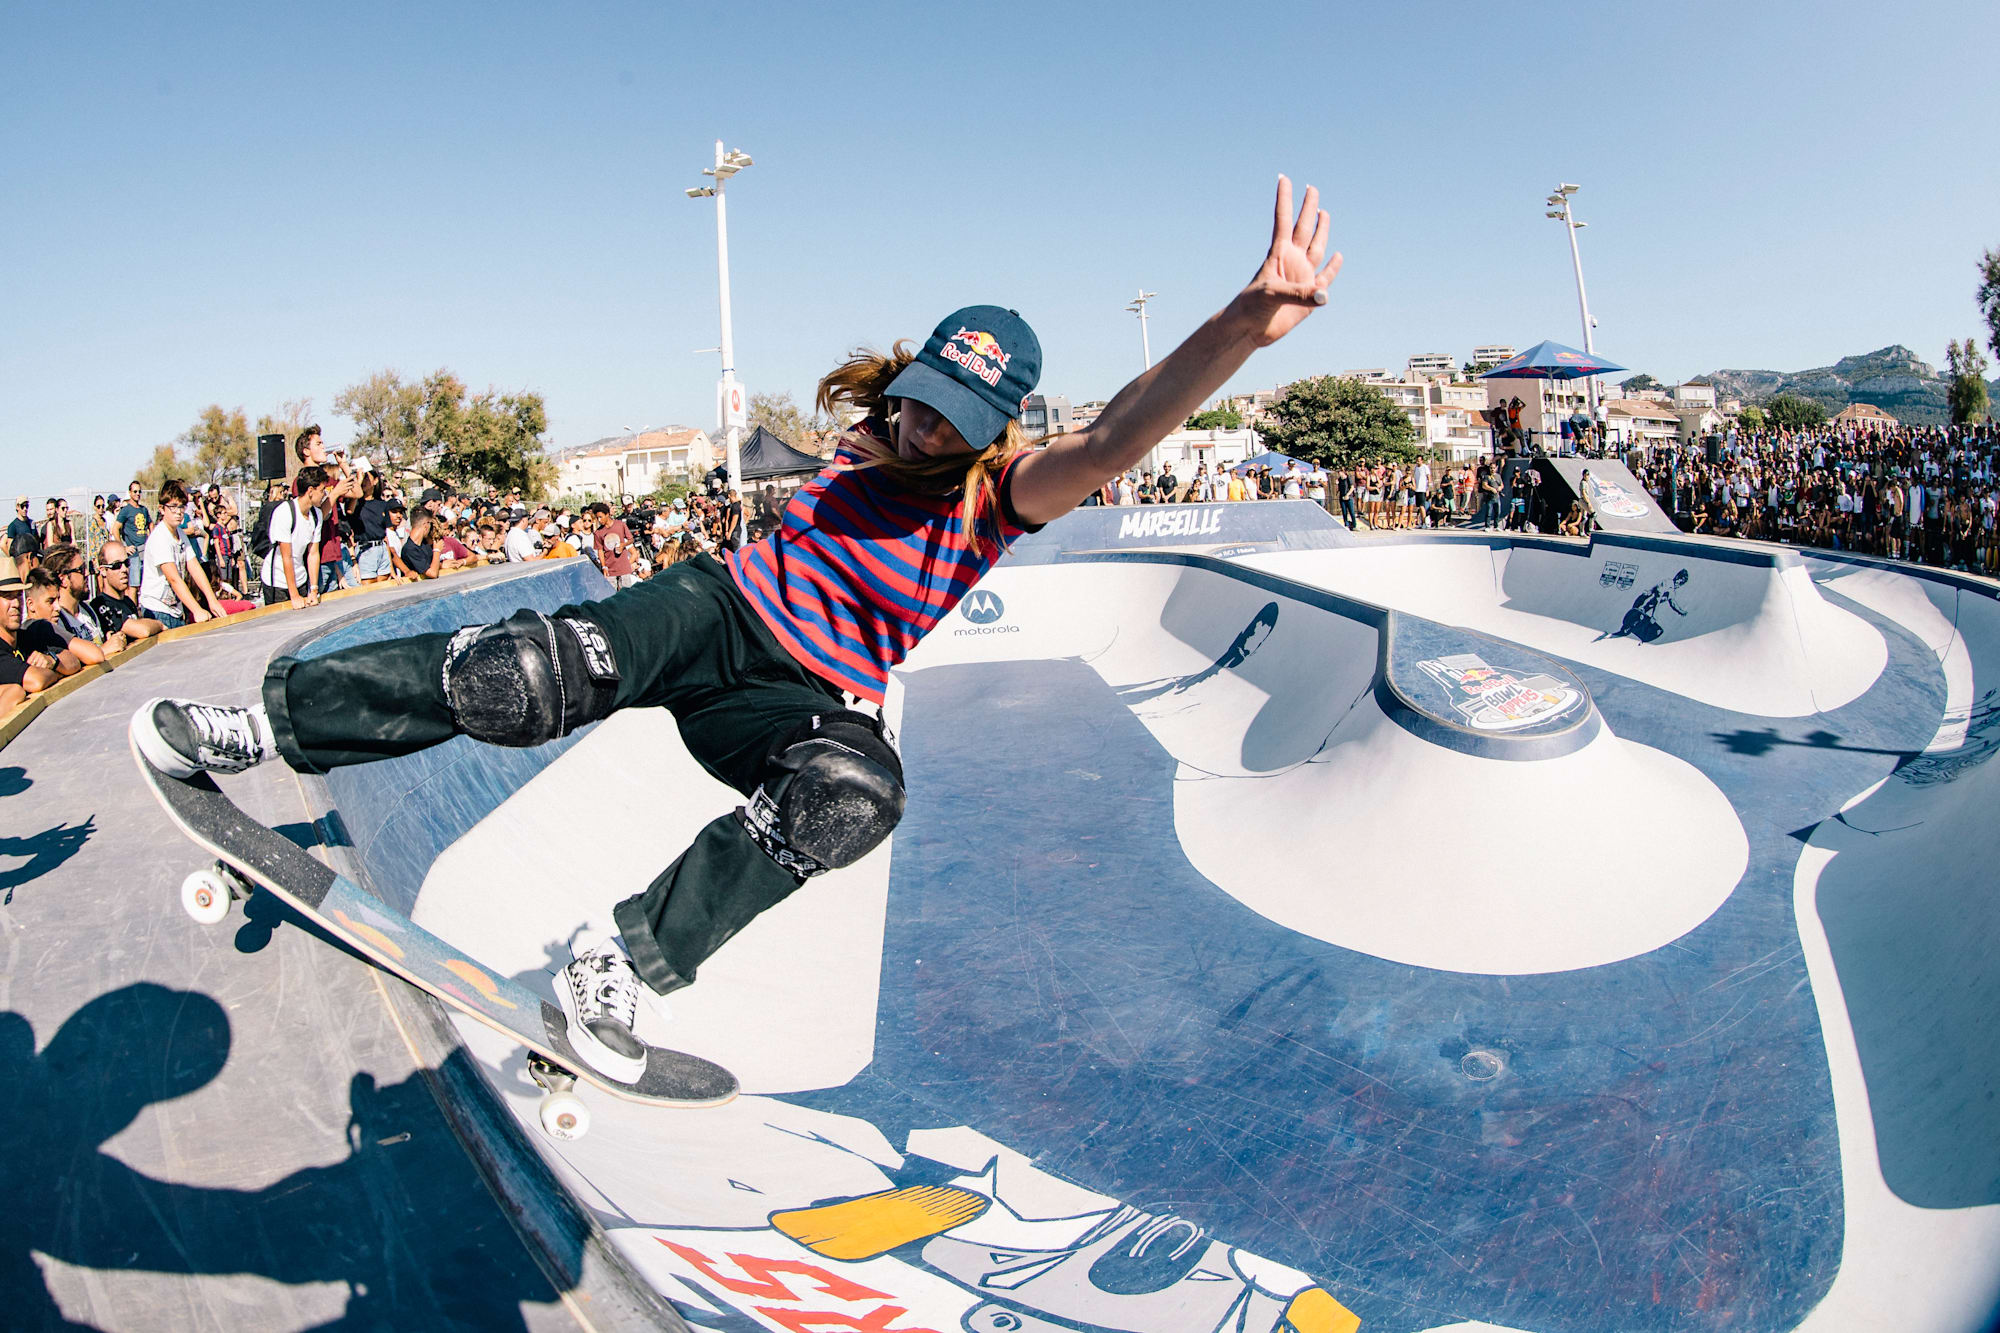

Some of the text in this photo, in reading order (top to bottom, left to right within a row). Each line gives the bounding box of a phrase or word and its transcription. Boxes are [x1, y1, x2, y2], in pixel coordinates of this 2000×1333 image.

[940, 342, 1003, 387] Red Bull
[1119, 508, 1224, 539] MARSEILLE
[954, 625, 1020, 636] motorola
[1461, 674, 1518, 695] Red Bull
[1485, 684, 1523, 707] BOWL
[1498, 689, 1539, 714] RIPPERS
